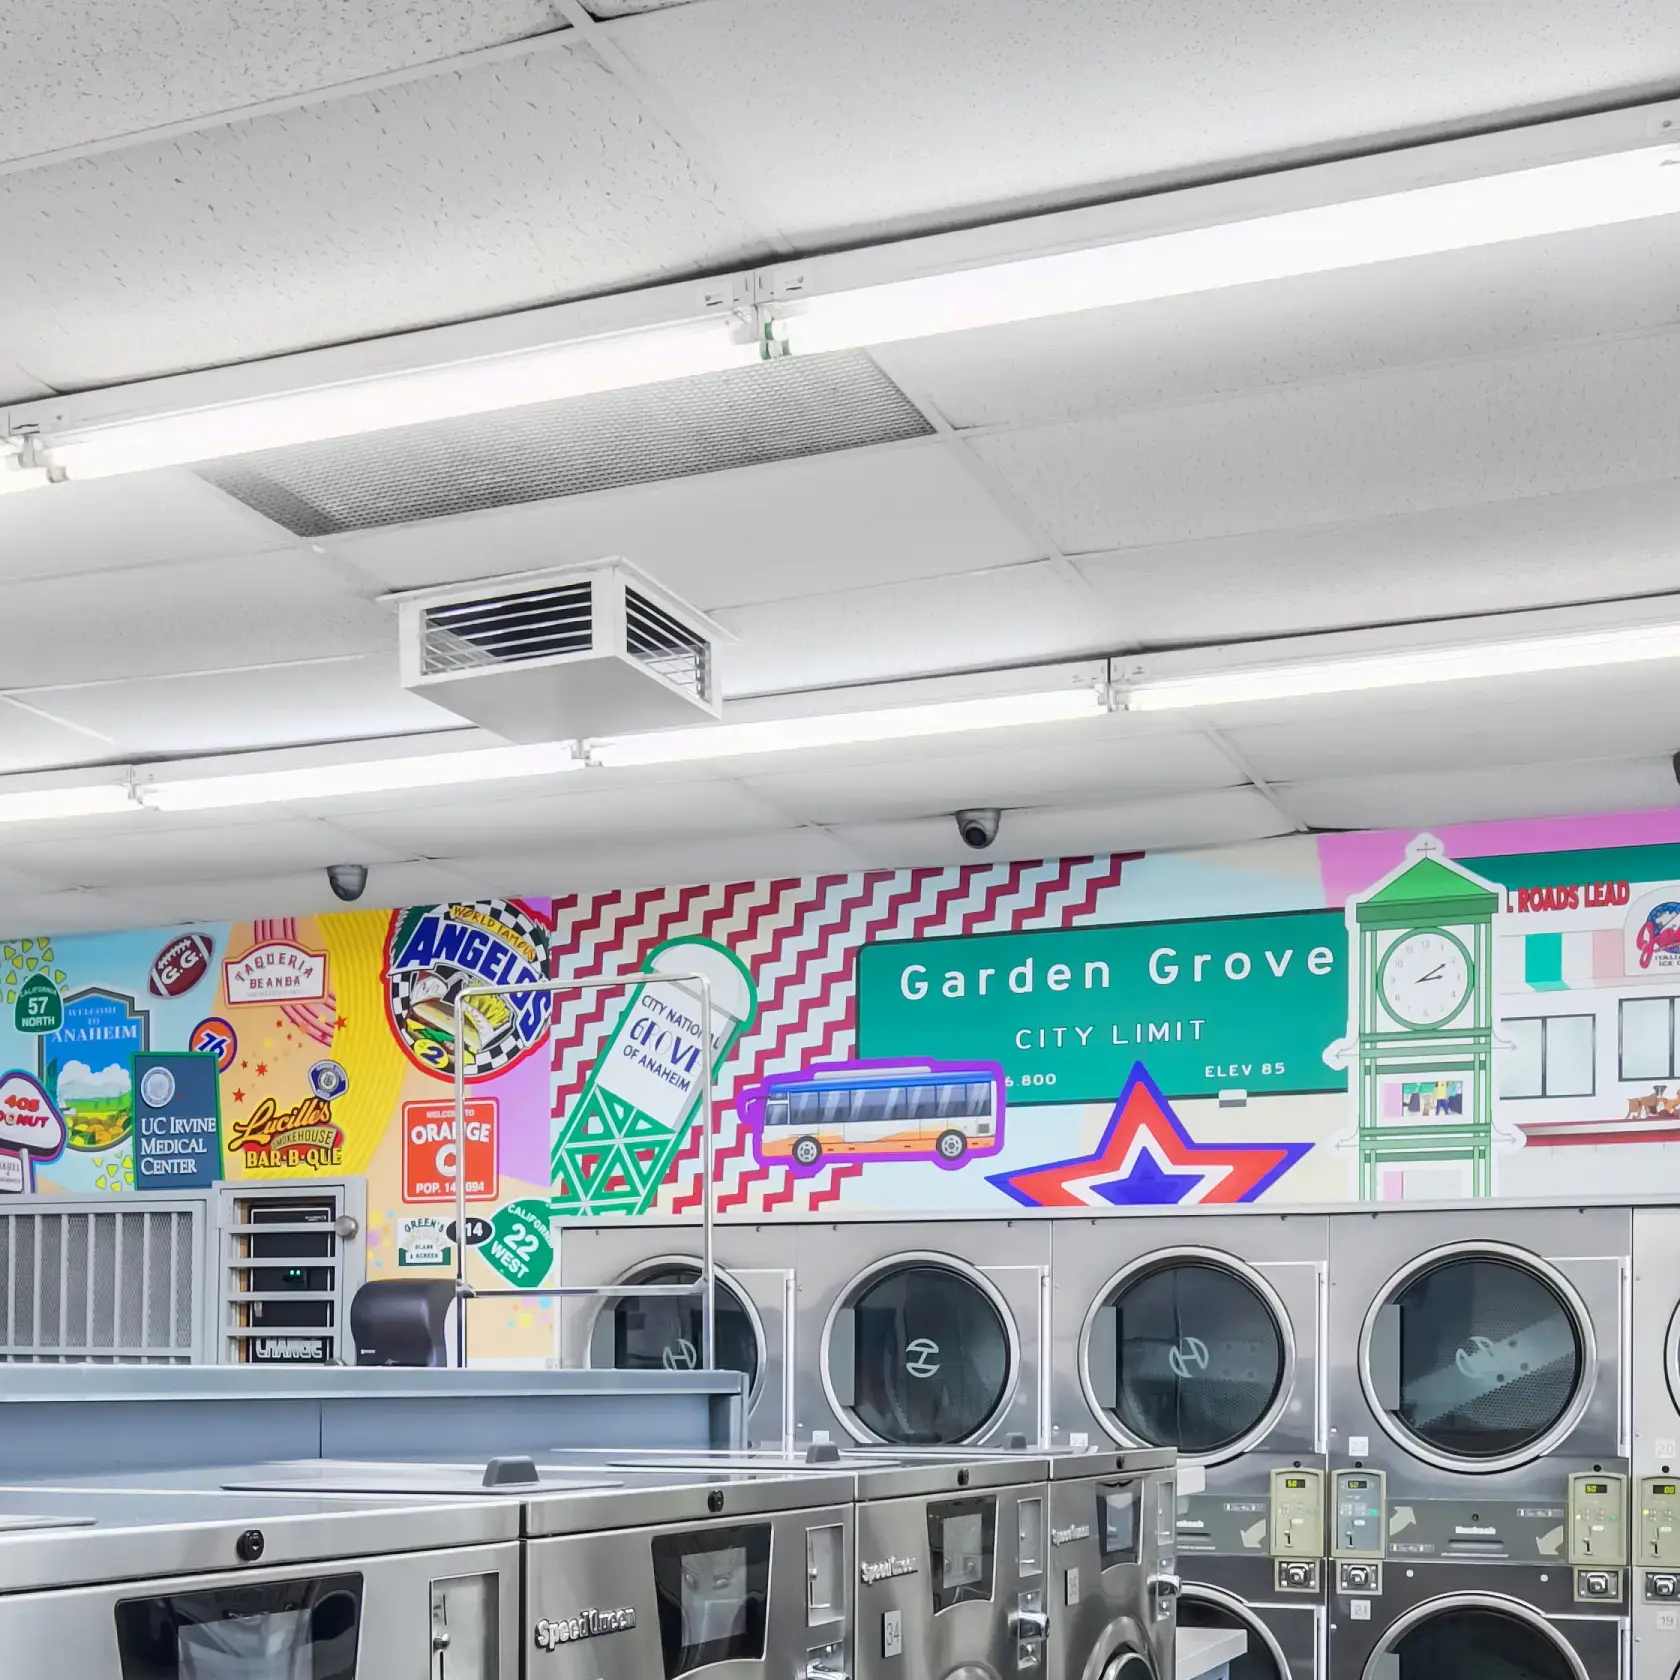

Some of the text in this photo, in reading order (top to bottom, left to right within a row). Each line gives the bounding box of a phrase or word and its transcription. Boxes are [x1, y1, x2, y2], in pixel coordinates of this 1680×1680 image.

[1517, 884, 1579, 913] ROADS
[1584, 880, 1631, 909] LEAD
[453, 905, 496, 928] WORLD
[235, 952, 313, 982] TAQUERIA
[900, 944, 1337, 1002] Garden Grove
[27, 996, 49, 1015] 57
[642, 995, 668, 1015] CITY
[21, 1016, 55, 1027] NORTH
[52, 1024, 137, 1043] ANAHEIM
[1015, 1018, 1206, 1051] CITY LIMIT
[195, 1029, 230, 1060] 76
[623, 1045, 691, 1093] OF ANAHEIM
[1204, 1061, 1286, 1078] ELEV 85
[141, 1116, 216, 1135] UC IRVINE
[228, 1097, 332, 1152] Lucille's
[141, 1138, 207, 1155] MEDICAL
[272, 1130, 334, 1149] SMOKEHOUSE
[141, 1157, 197, 1175] CENTER
[416, 1182, 441, 1194] POP.
[404, 1218, 445, 1233] GREEN'S
[504, 1223, 539, 1262] 22
[490, 1240, 529, 1278] WEST
[535, 1607, 637, 1653] Speed Queen
[1661, 1616, 1674, 1627] 19
[886, 1620, 900, 1646] 34
